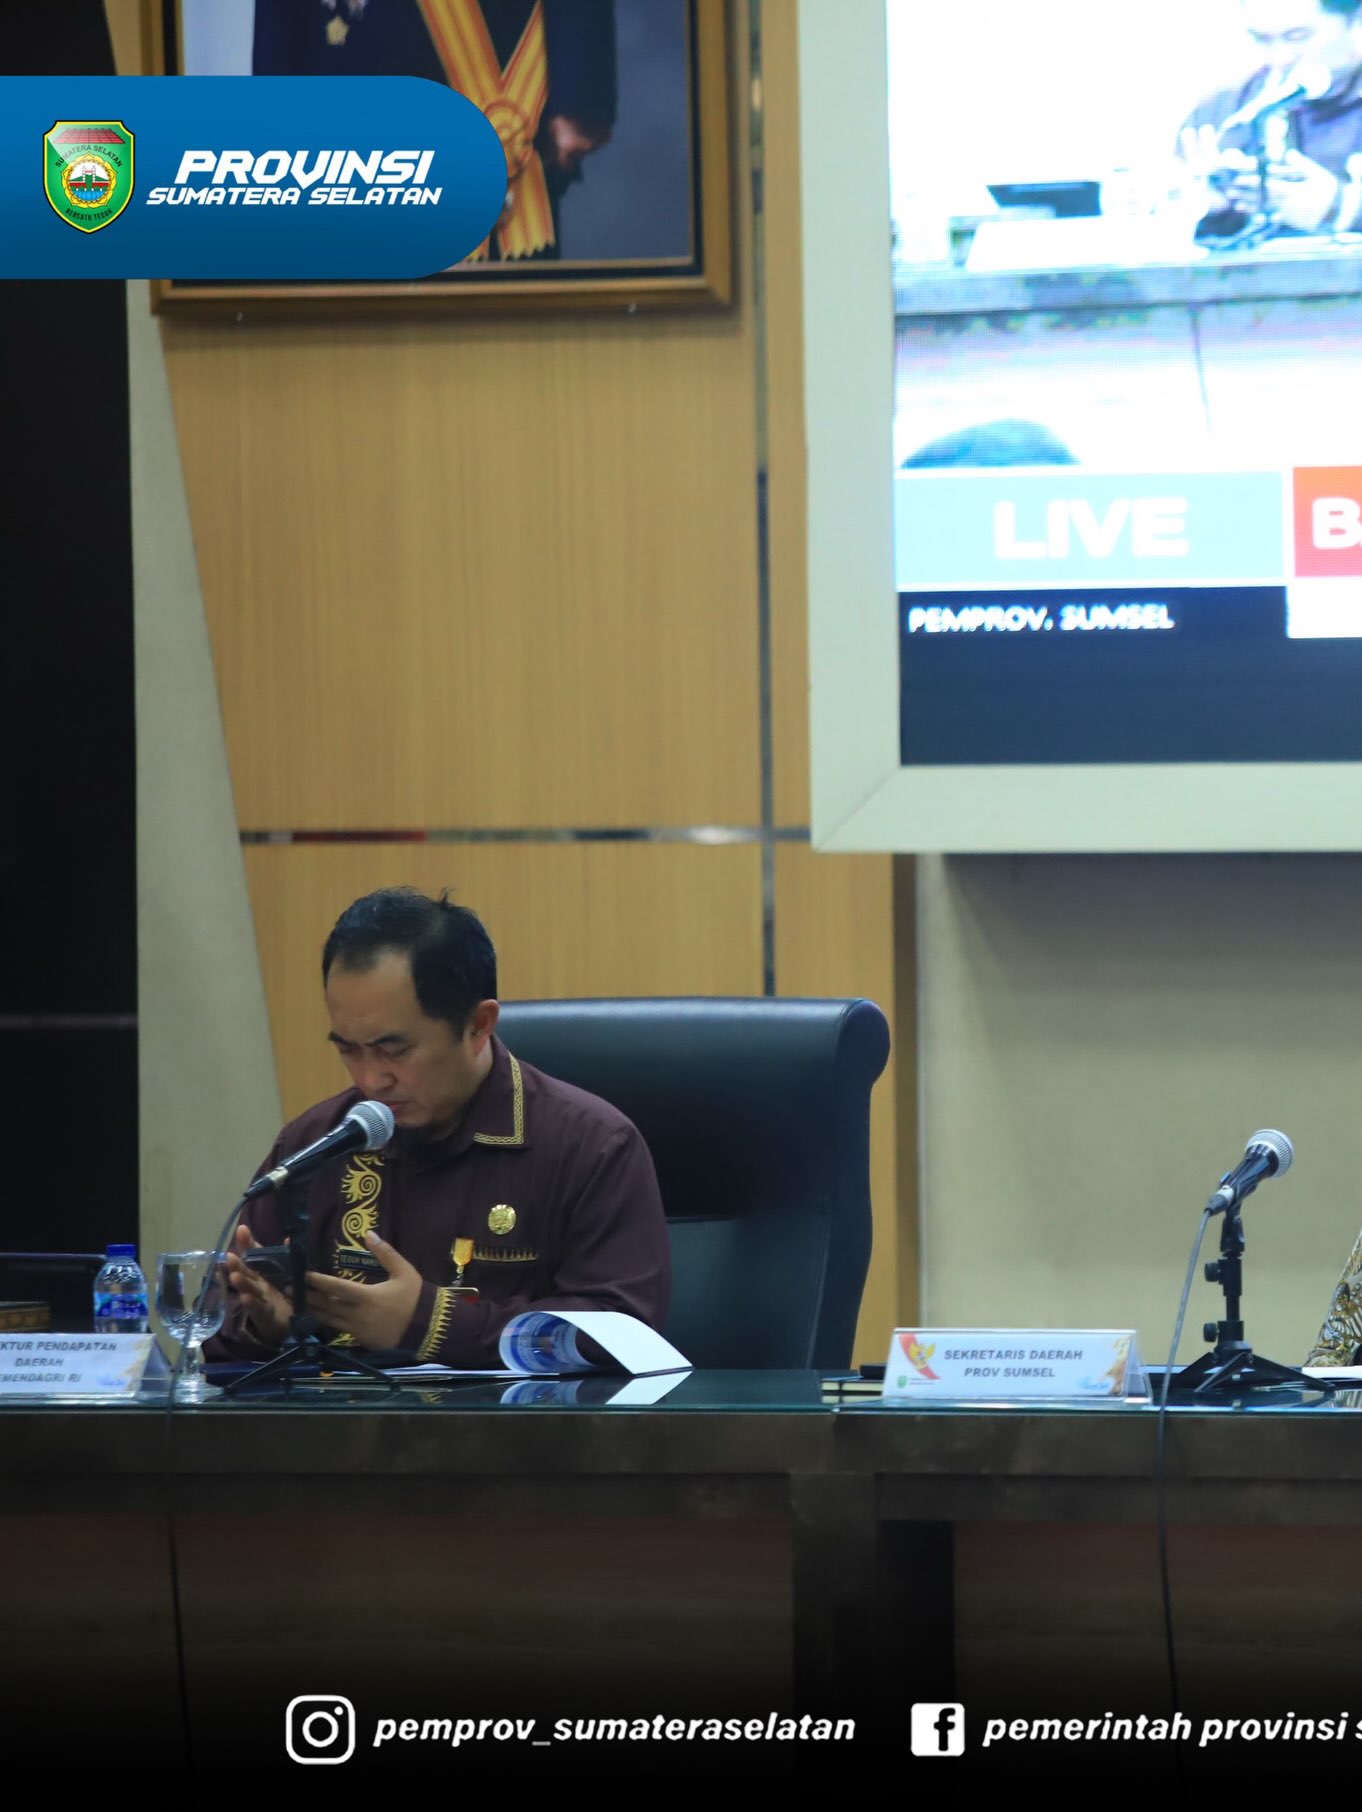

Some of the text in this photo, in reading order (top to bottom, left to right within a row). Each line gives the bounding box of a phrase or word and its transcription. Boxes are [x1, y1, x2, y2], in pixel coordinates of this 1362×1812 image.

[994, 497, 1190, 560] LIVE
[909, 604, 1176, 633] PEMPROV. SUMSEL
[36, 1341, 117, 1351] PENDAPATAN
[944, 1350, 1083, 1360] SEKRETARIS DAERAH
[15, 1358, 64, 1367] DAERAH
[964, 1367, 1055, 1377] PROV SUMSEL
